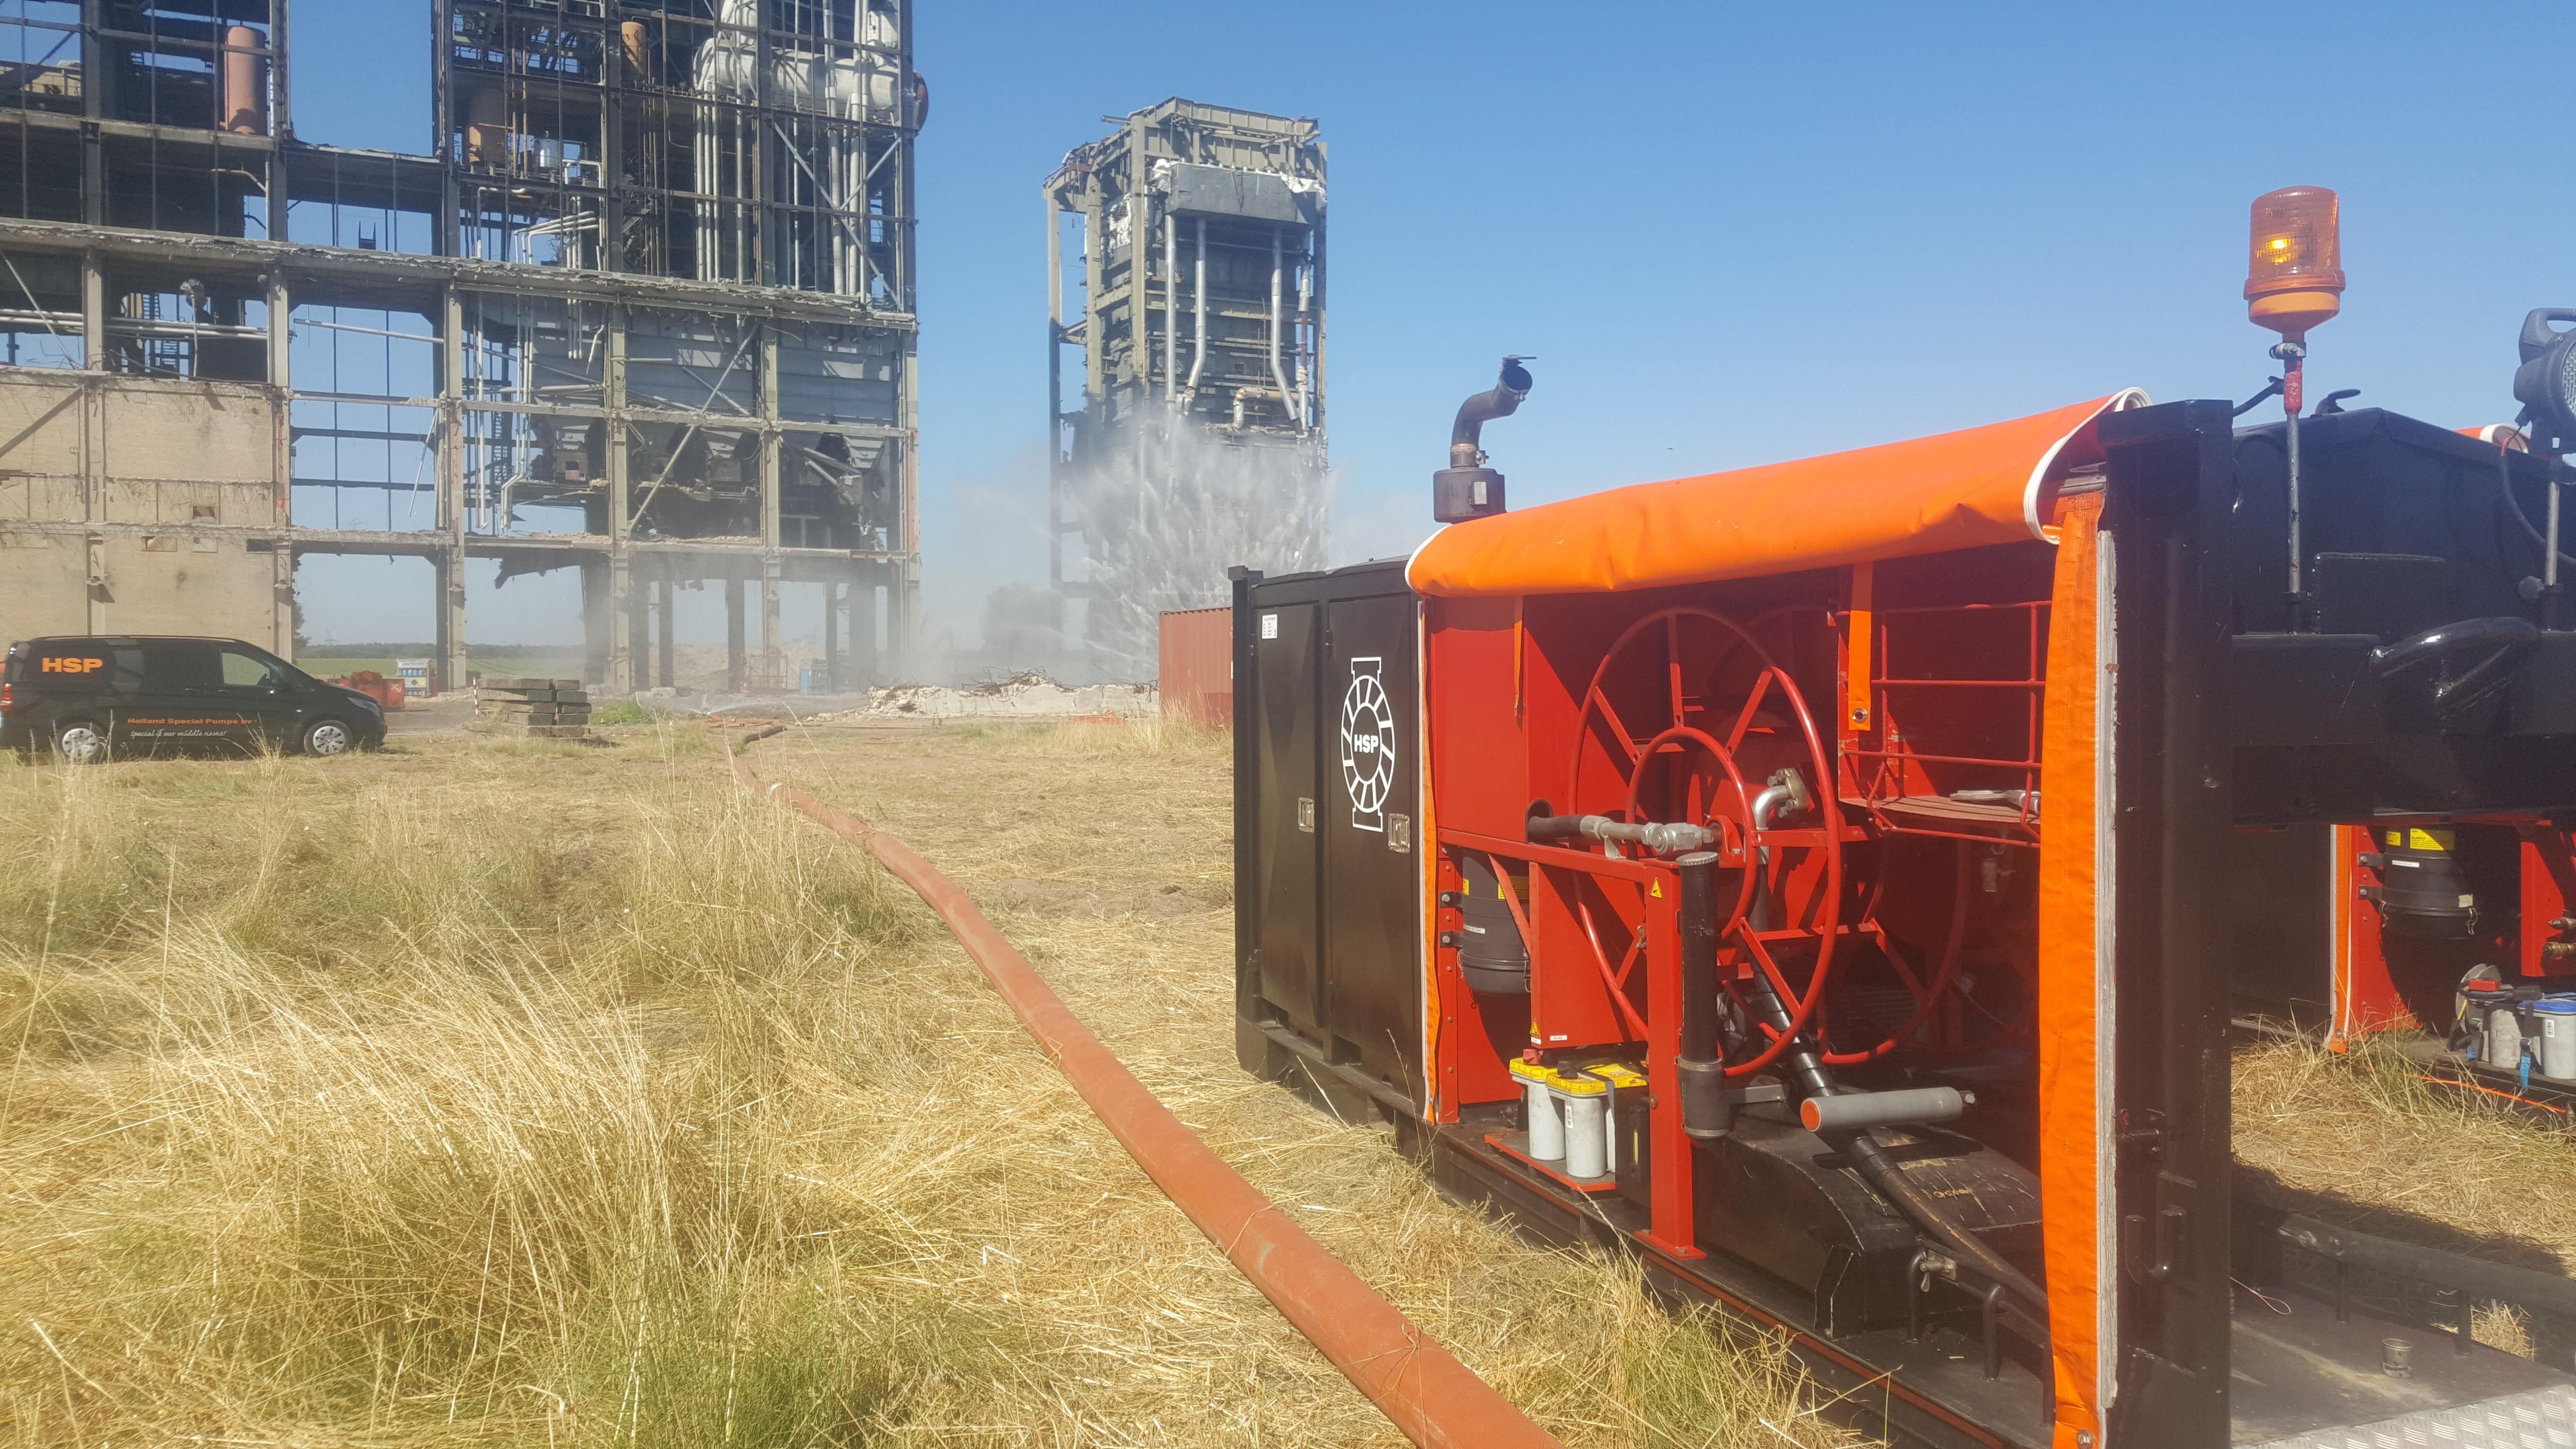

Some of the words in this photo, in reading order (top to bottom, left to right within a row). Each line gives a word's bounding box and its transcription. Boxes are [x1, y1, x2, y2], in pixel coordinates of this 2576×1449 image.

[42, 658, 103, 673] HSP
[130, 729, 156, 739] Special
[1354, 734, 1379, 753] HSP
